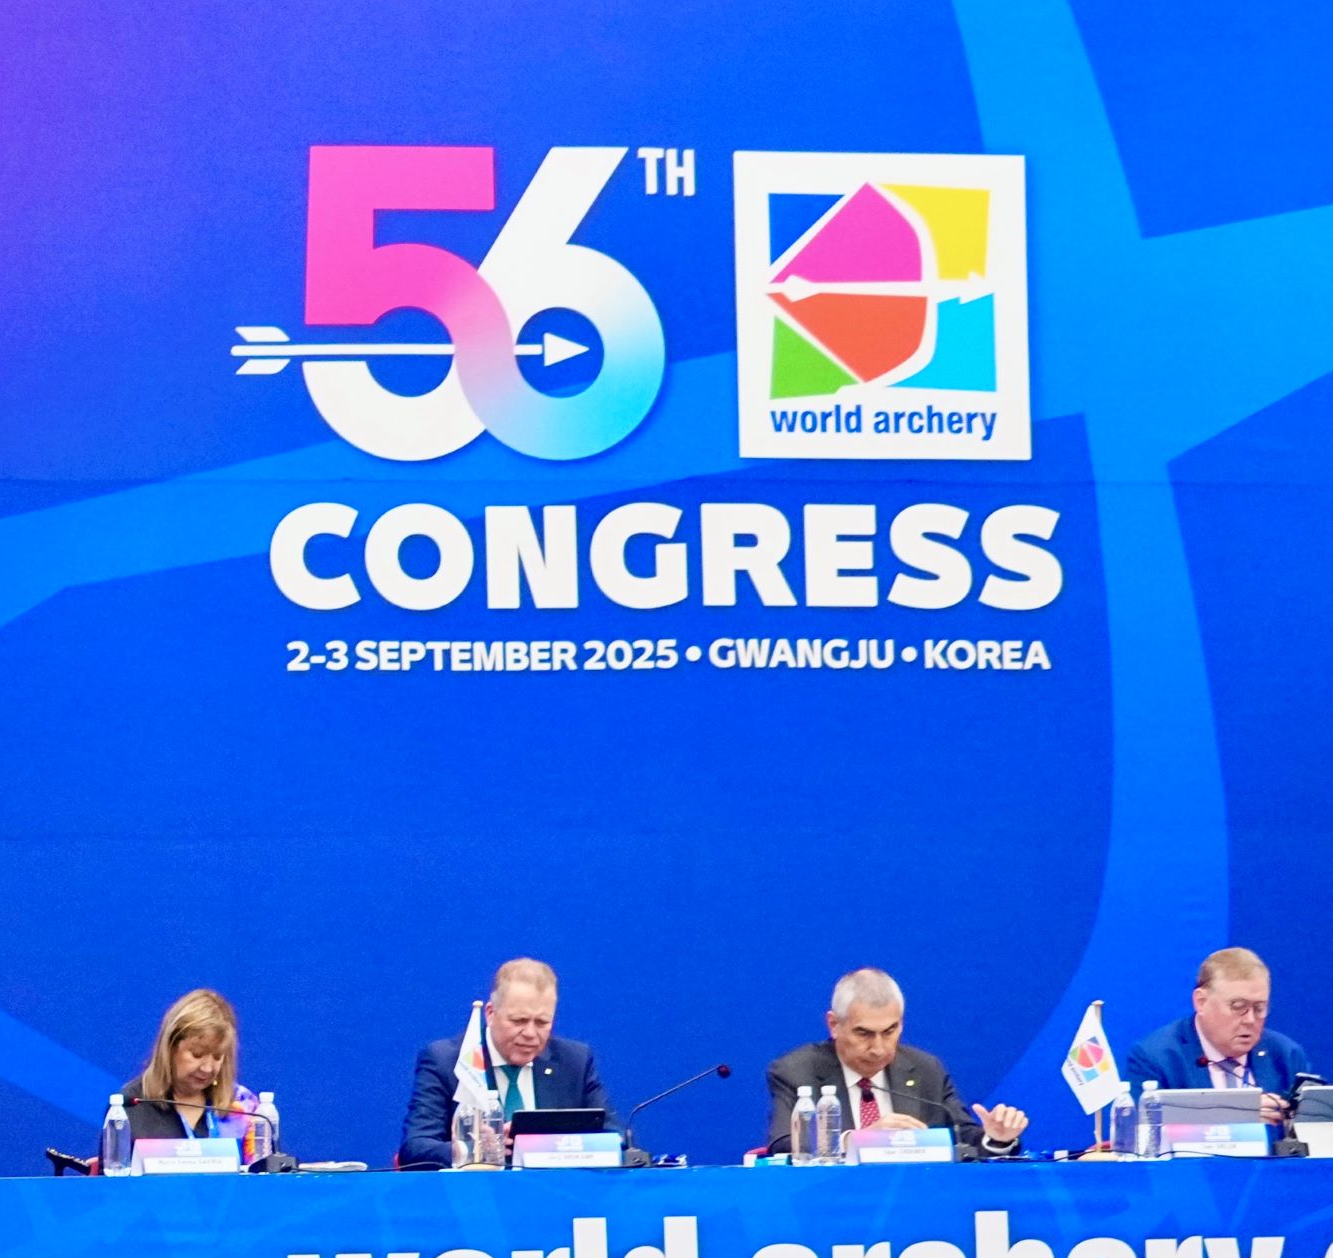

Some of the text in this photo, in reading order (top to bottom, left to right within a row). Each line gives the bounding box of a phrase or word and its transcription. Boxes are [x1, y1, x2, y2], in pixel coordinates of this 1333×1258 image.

[770, 404, 999, 442] world archery
[269, 501, 1065, 612] CONGRESS
[285, 638, 1051, 673] 2-3 SEPTEMBER 2025 GWANGJU KOREA
